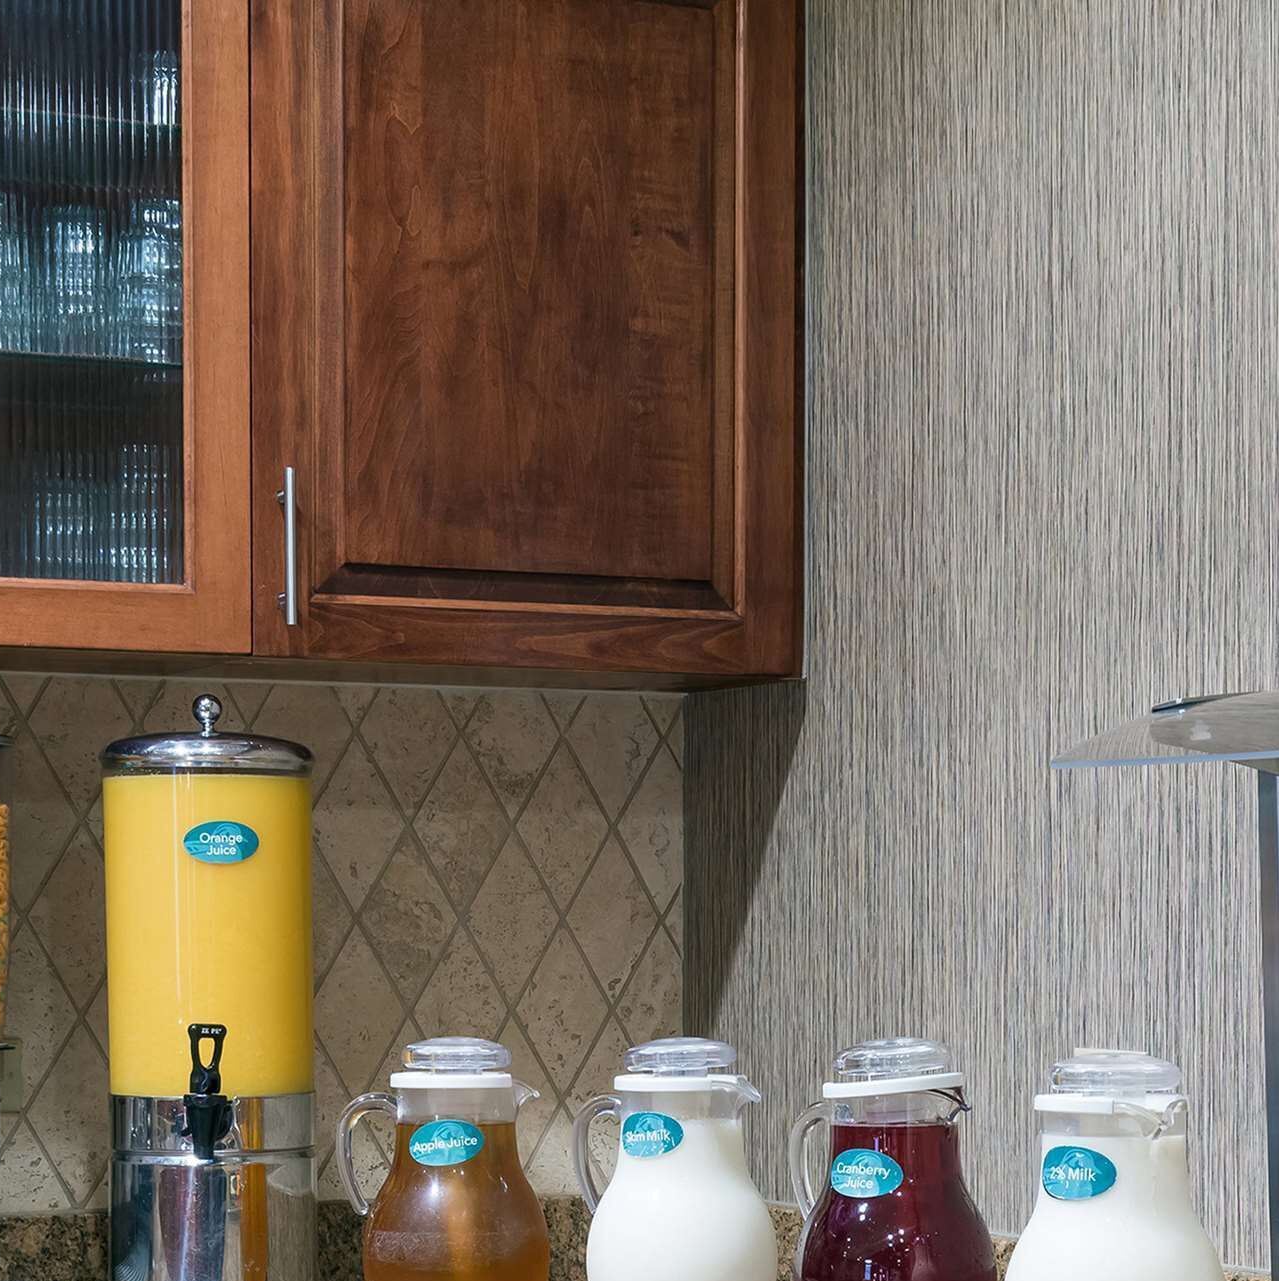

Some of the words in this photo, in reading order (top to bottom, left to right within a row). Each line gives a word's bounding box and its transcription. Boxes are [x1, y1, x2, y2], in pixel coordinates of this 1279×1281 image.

[199, 832, 243, 845] Orange
[206, 845, 236, 856] Juice
[647, 1128, 671, 1142] Milk
[413, 1137, 445, 1154] Apple
[446, 1135, 478, 1148] Juice
[836, 1162, 891, 1180] Cranberry
[1067, 1168, 1096, 1182] Milk
[844, 1176, 874, 1189] Juice
